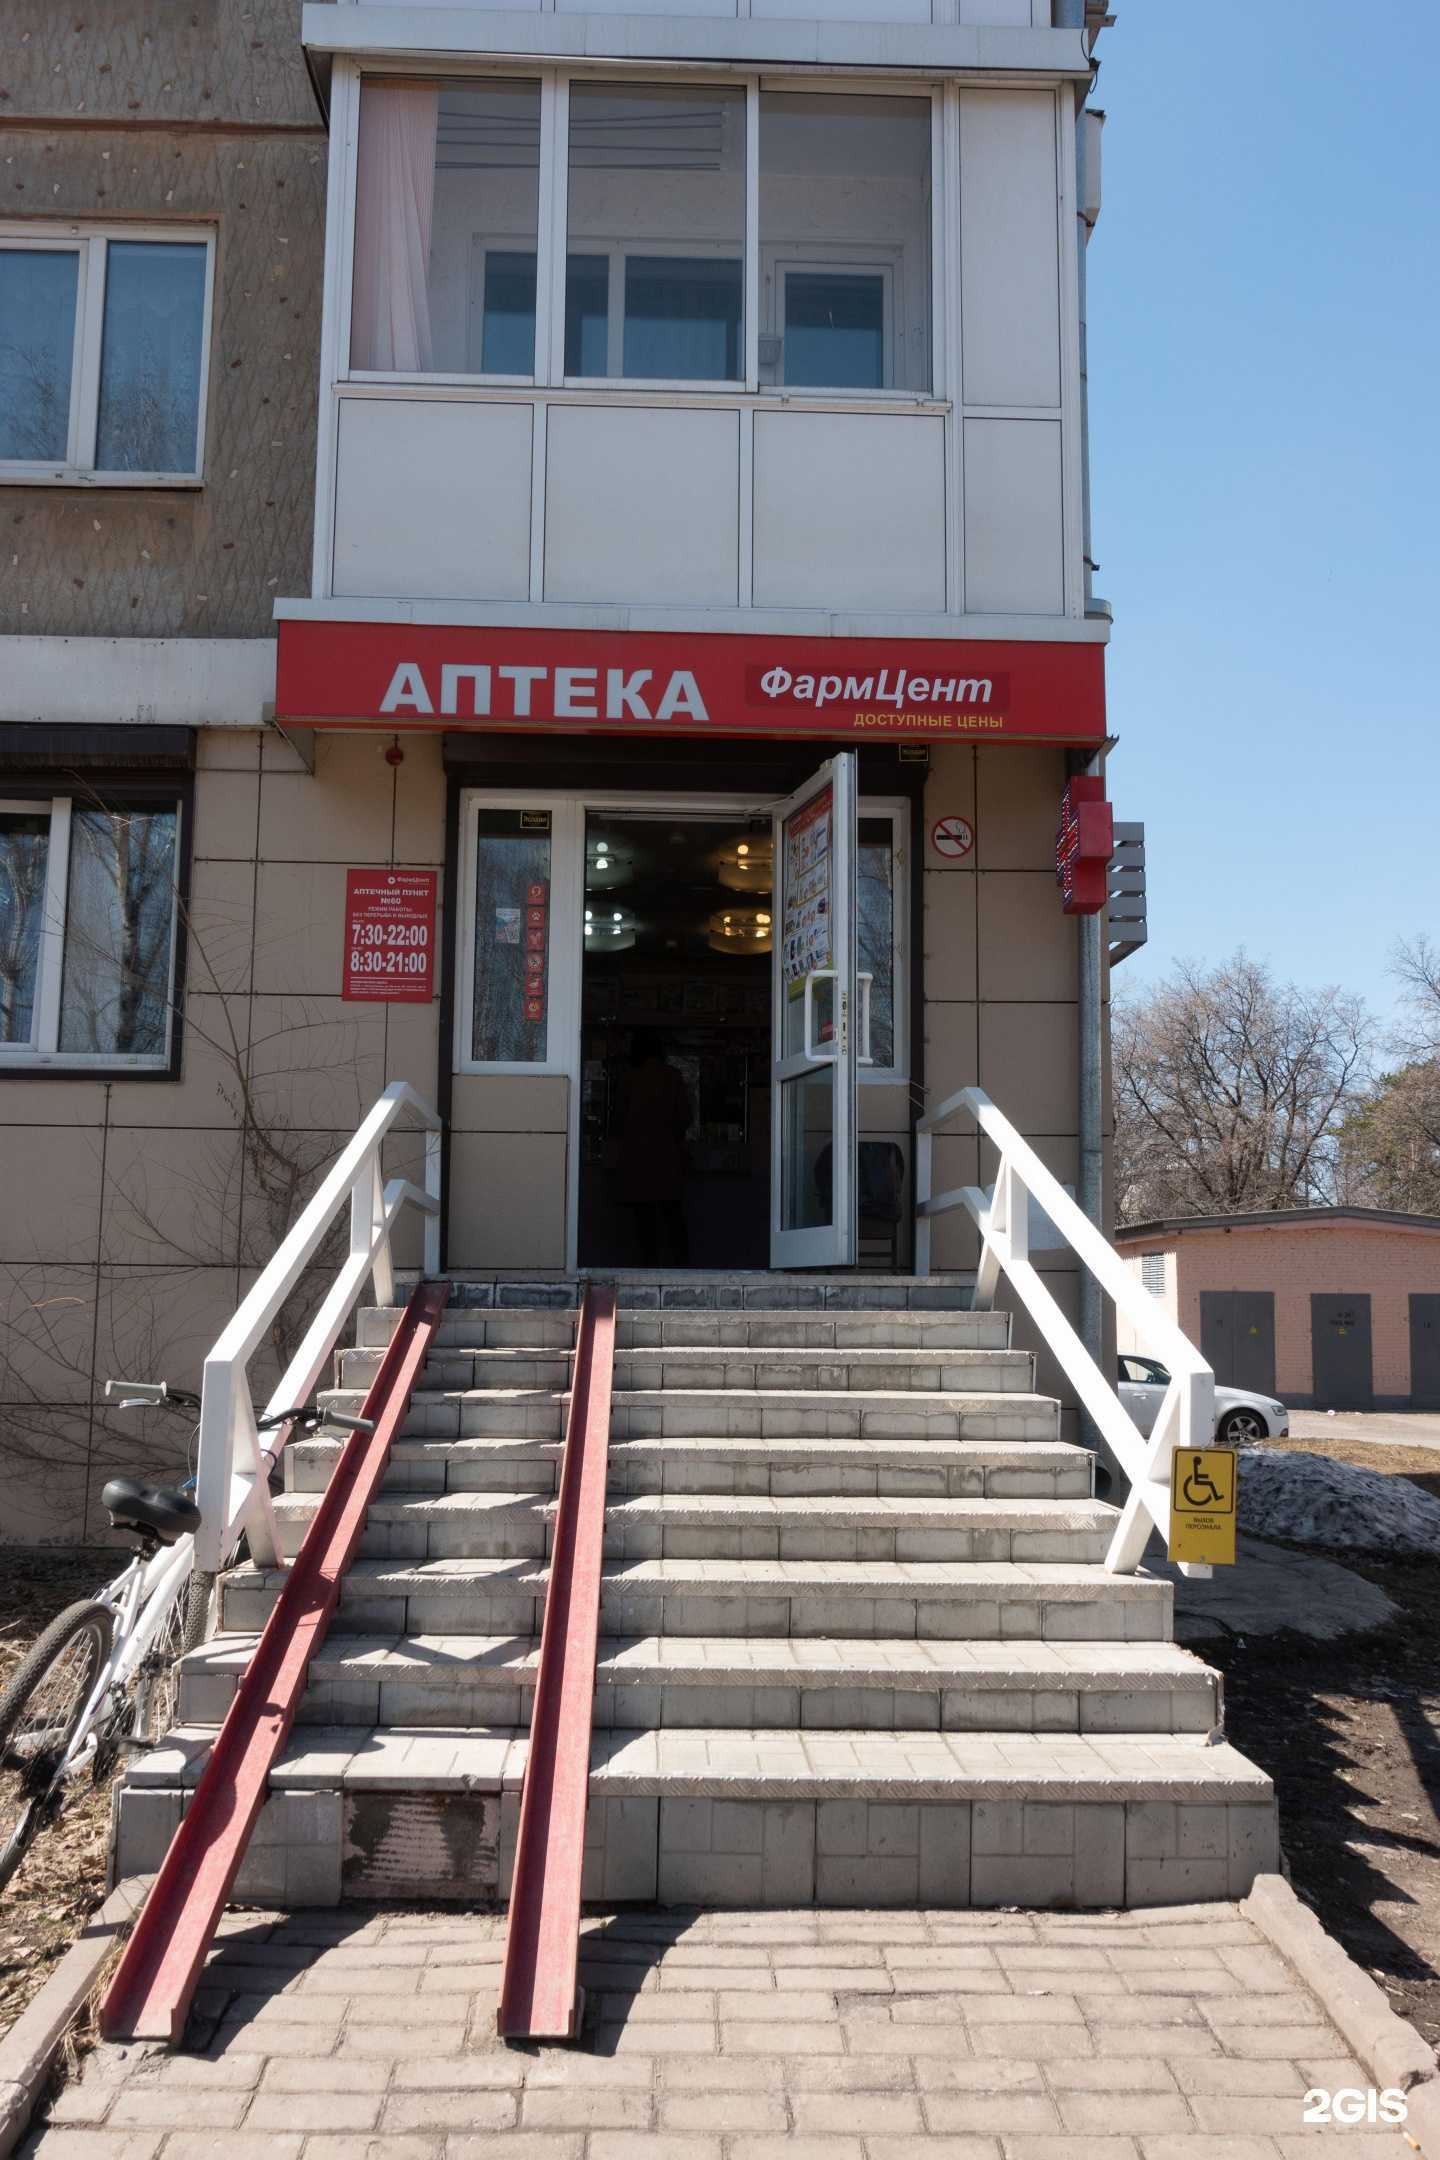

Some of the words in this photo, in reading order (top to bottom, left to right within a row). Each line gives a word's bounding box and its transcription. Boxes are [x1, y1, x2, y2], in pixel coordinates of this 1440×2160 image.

[379, 662, 710, 721] АПТЕКА
[760, 666, 993, 708] ФармЦент
[853, 713, 953, 728] ДОСТУПНЫЕ
[957, 714, 1004, 729] ЦЕНЫ
[352, 924, 427, 946] 7:30-22:00
[351, 951, 426, 972] 8:30-21:00
